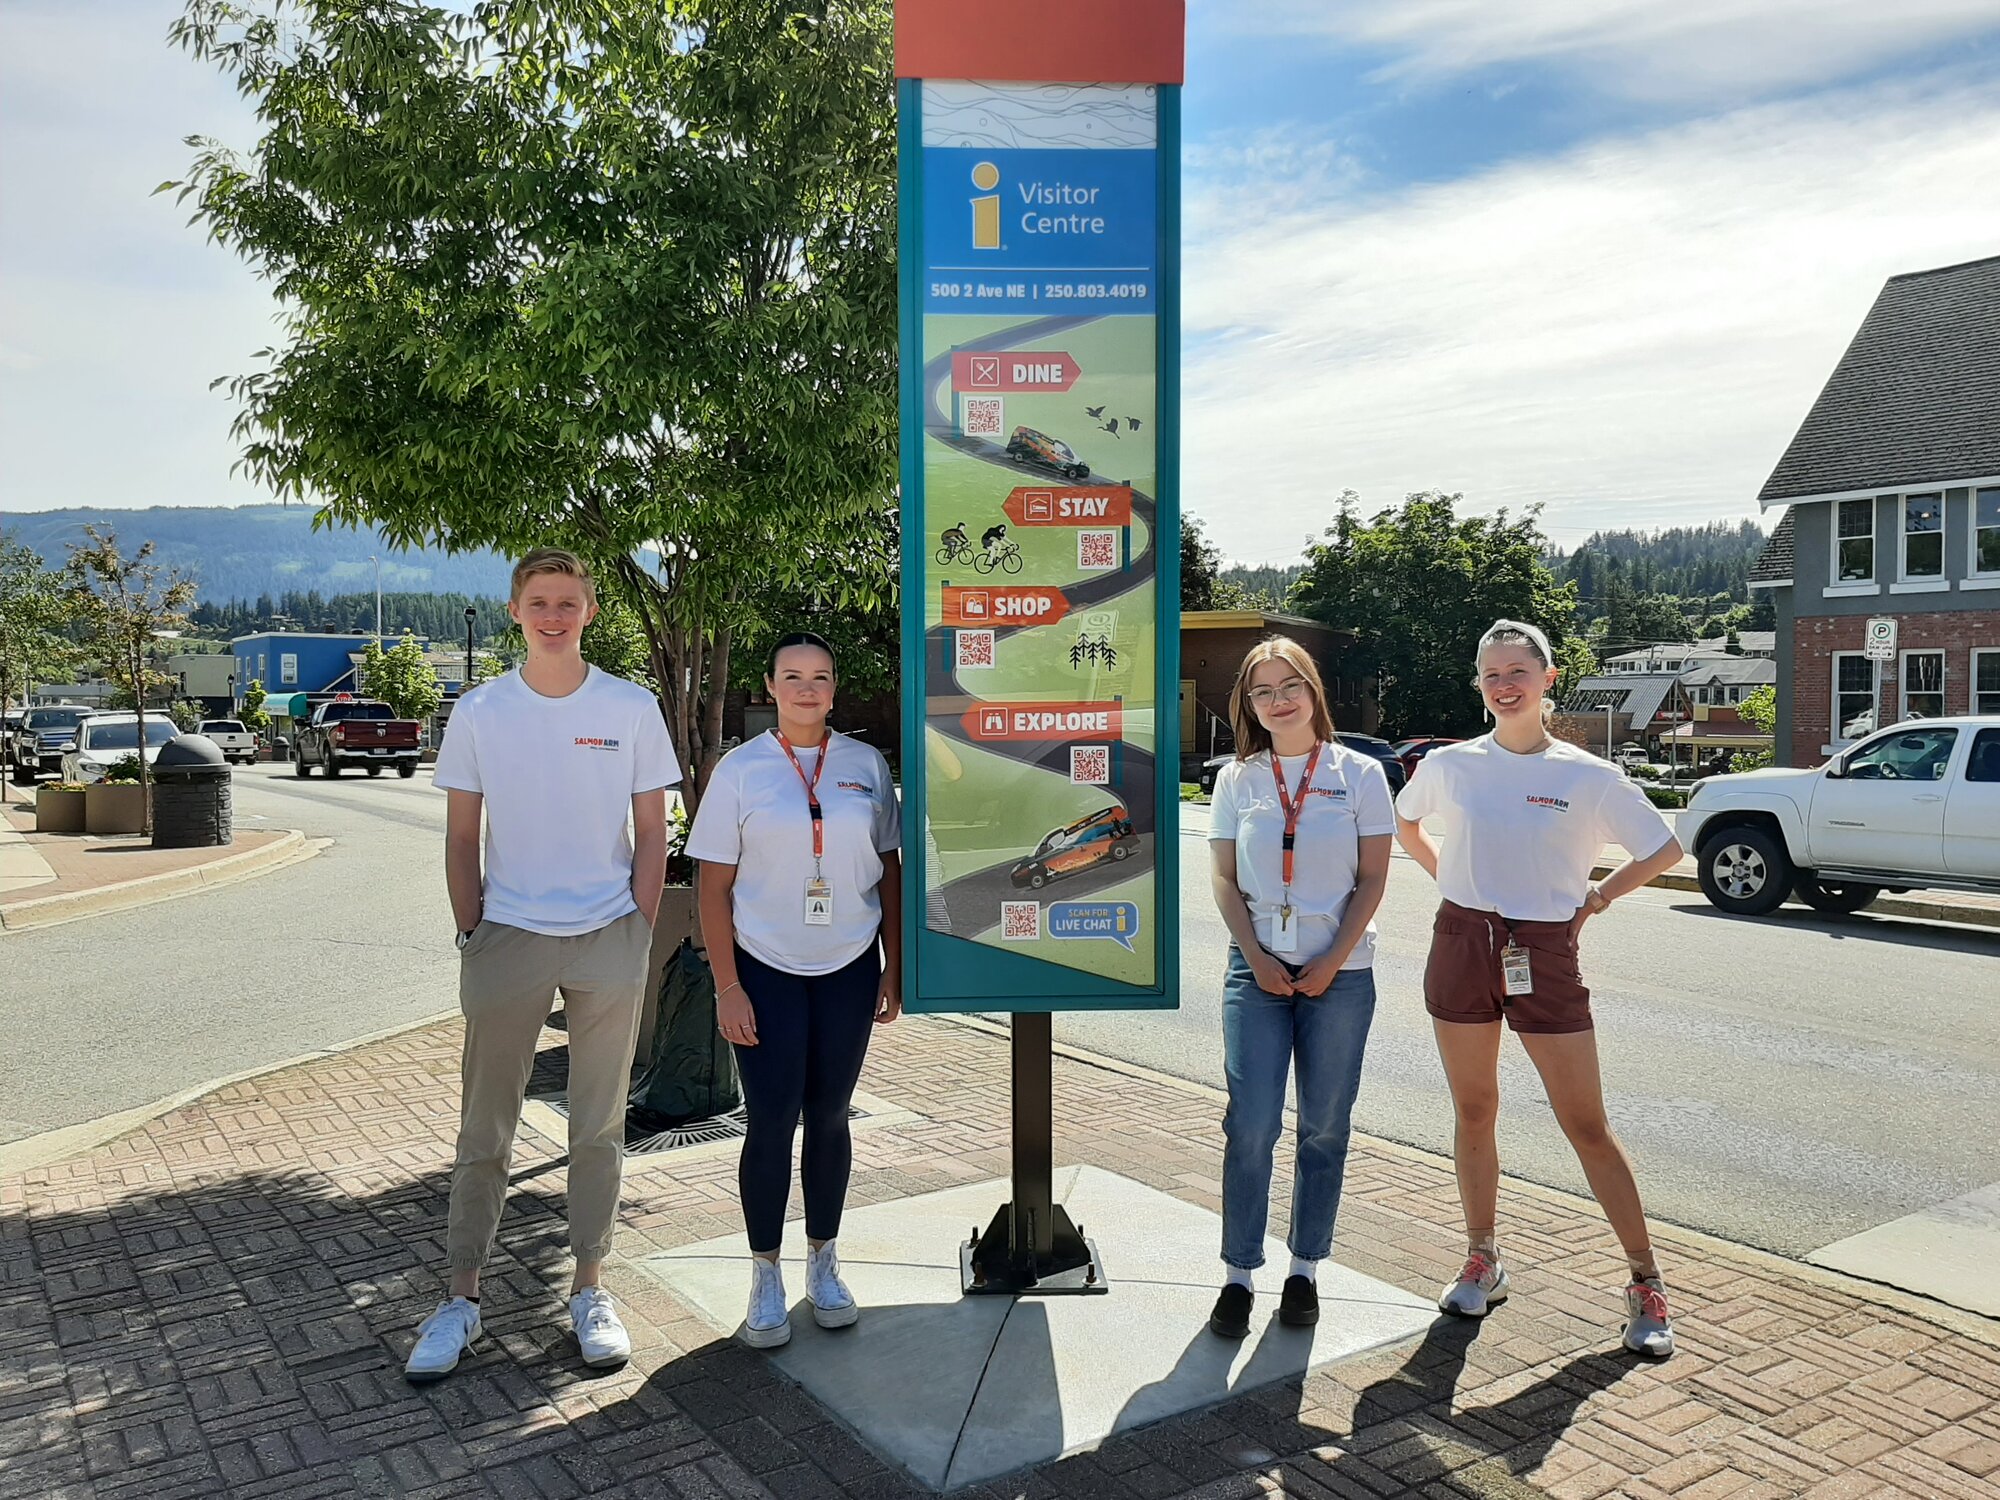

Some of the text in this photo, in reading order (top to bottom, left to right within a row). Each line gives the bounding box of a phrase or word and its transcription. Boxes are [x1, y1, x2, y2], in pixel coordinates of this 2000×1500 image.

[1018, 182, 1100, 205] Visitor
[1020, 212, 1105, 234] Centre
[931, 283, 1147, 298] 500 2 Ave NE 250.803.4019
[1012, 364, 1063, 384] DINE
[1058, 497, 1109, 517] STAY
[994, 597, 1051, 616] SHOP
[1877, 626, 1887, 636] P
[1014, 712, 1108, 731] EXPLORE
[1068, 908, 1108, 918] SCAN FOR
[1055, 919, 1080, 931] LIVE
[1083, 919, 1112, 931] CHAT
